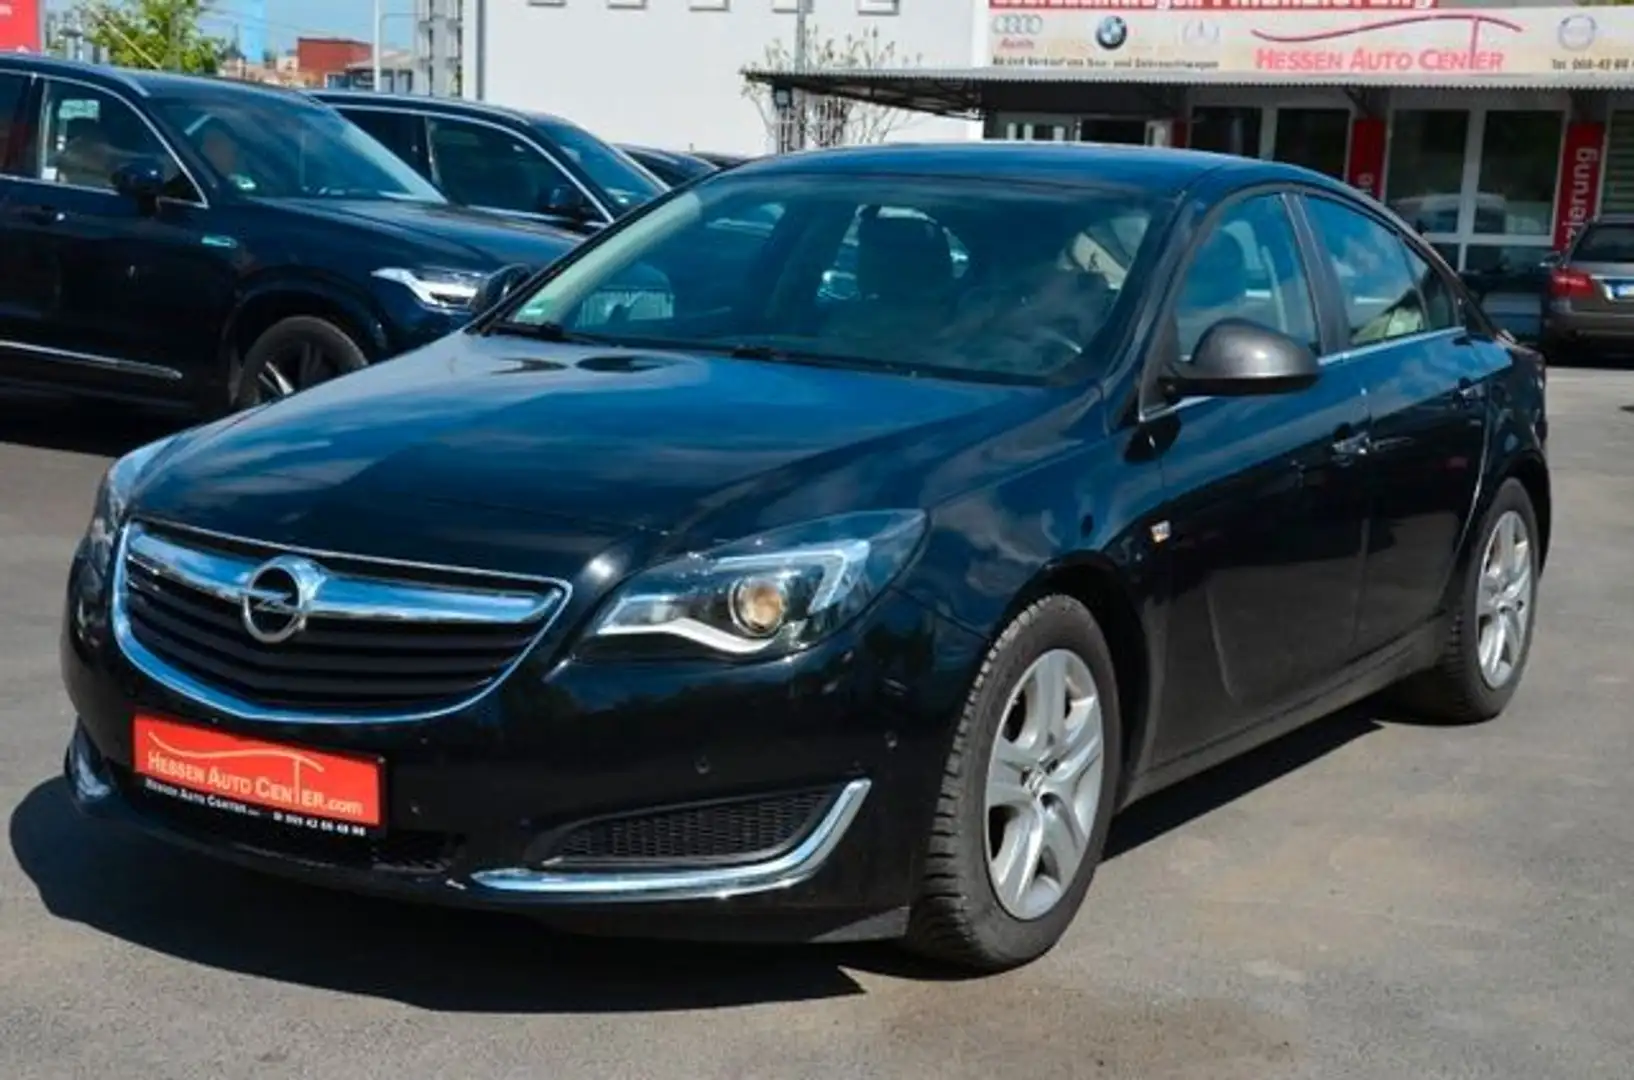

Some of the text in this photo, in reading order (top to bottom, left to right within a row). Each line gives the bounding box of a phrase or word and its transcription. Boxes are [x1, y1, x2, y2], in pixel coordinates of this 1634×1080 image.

[1255, 47, 1504, 70] HESSEN AUTO CENTER
[147, 751, 206, 784] HESSEN
[206, 765, 253, 796] AUTO
